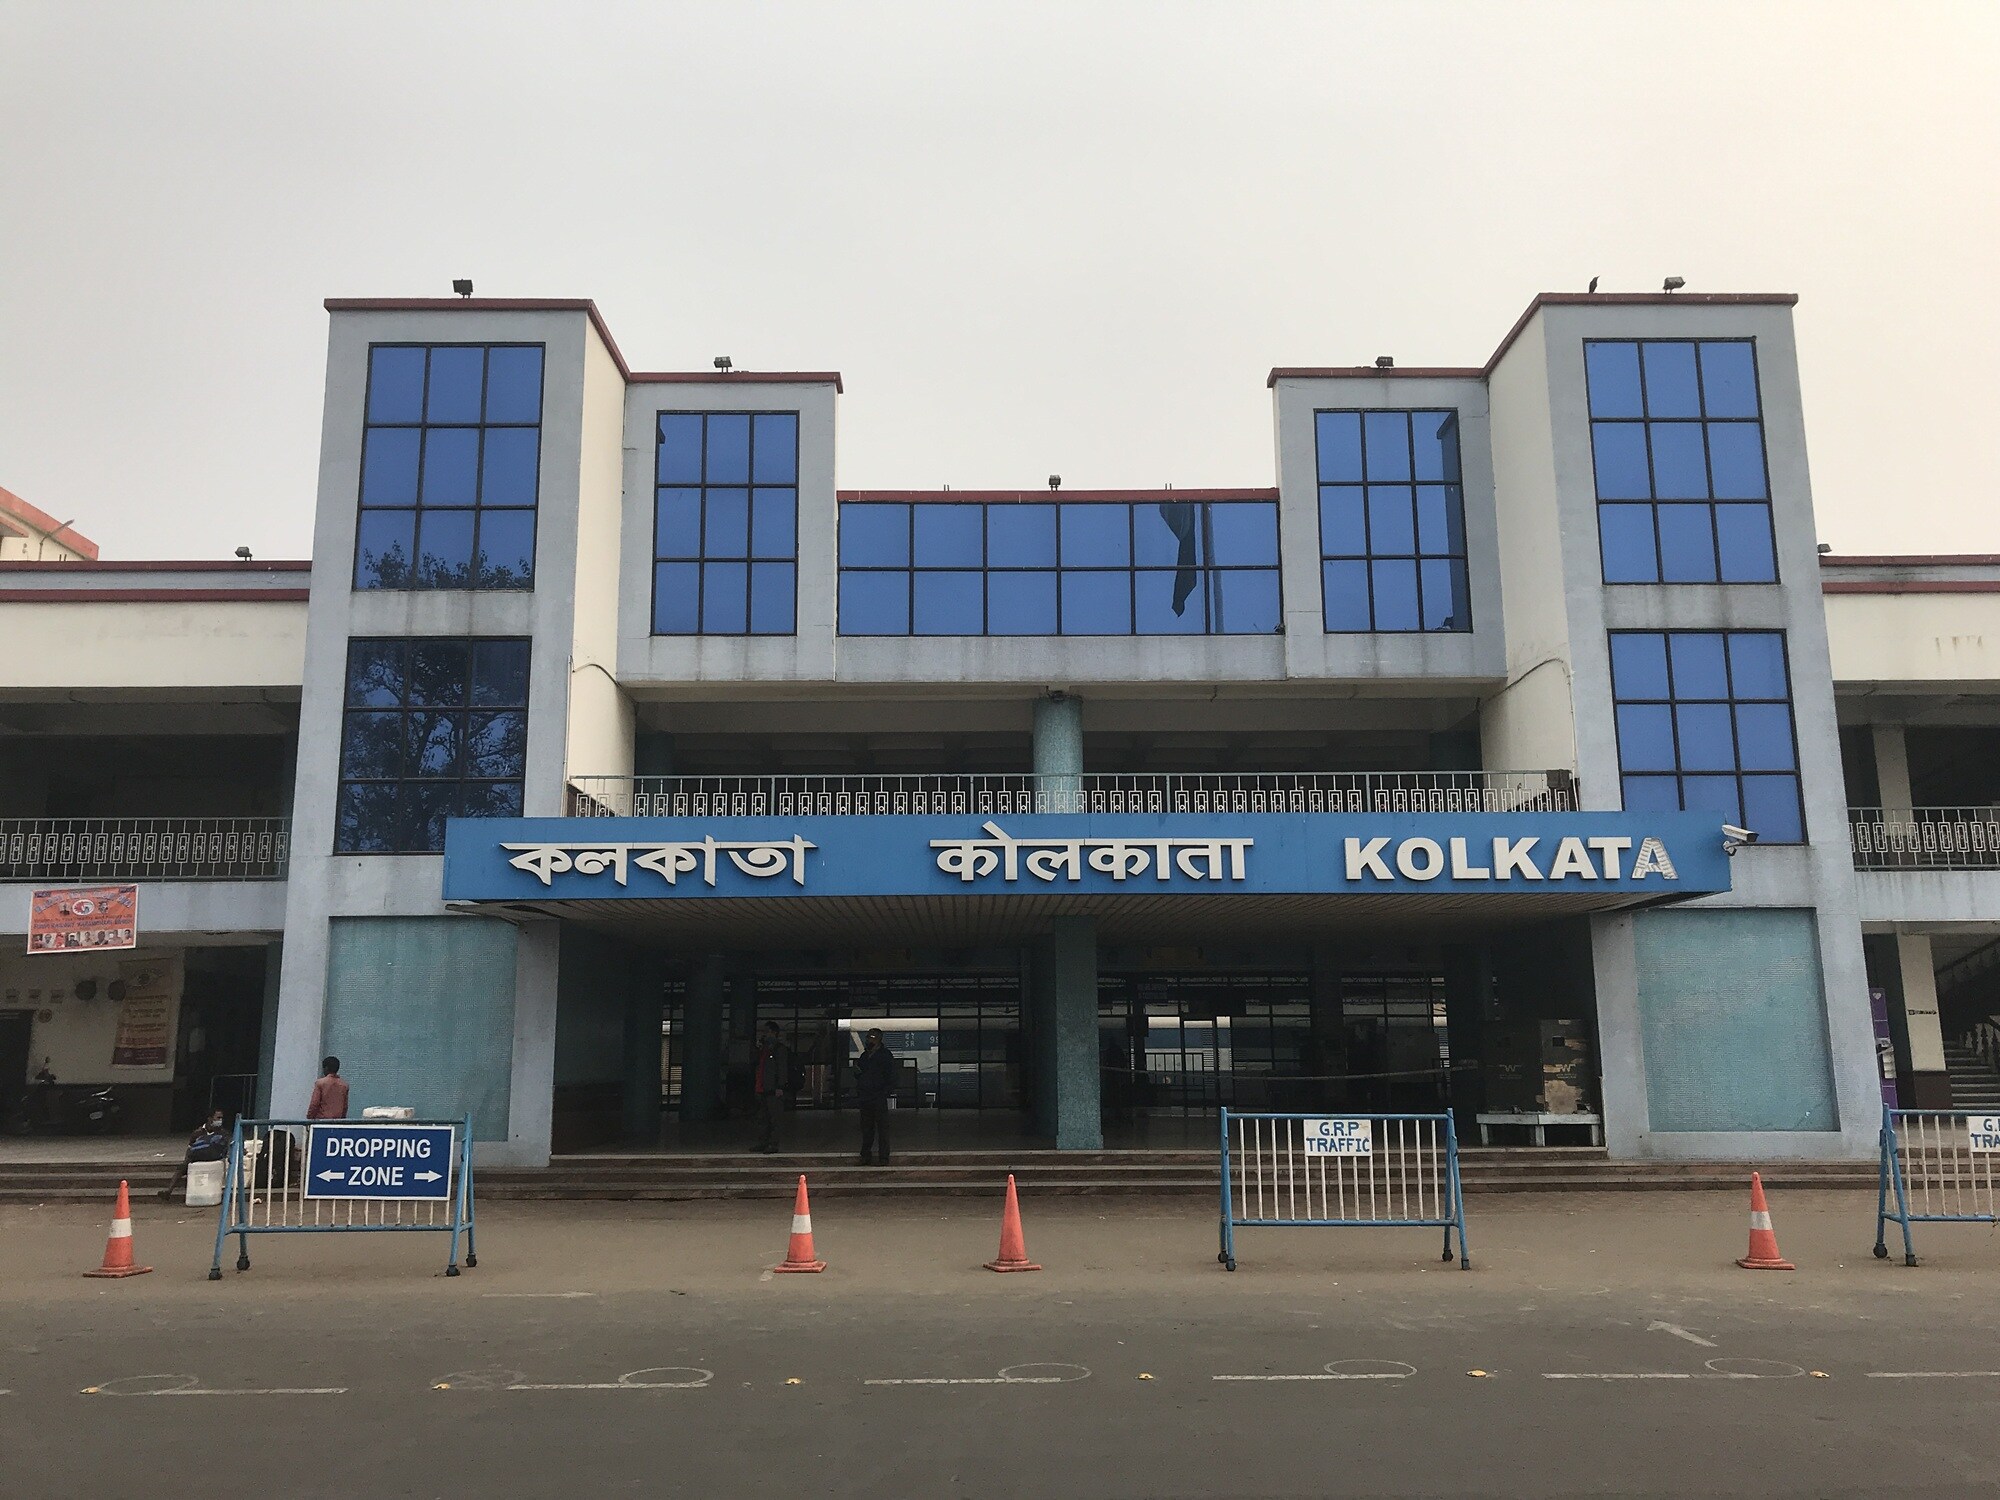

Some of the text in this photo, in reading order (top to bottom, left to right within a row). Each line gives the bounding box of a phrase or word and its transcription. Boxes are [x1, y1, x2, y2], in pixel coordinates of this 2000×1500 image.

[499, 834, 818, 887] কলকাতা
[930, 820, 1254, 882] कोलकाता
[1344, 836, 1678, 882] KOLKATA
[1319, 1121, 1360, 1137] G.R.P
[326, 1137, 431, 1159] DROPPING
[1305, 1137, 1370, 1153] TRAFFIC
[348, 1166, 404, 1186] ZONE
